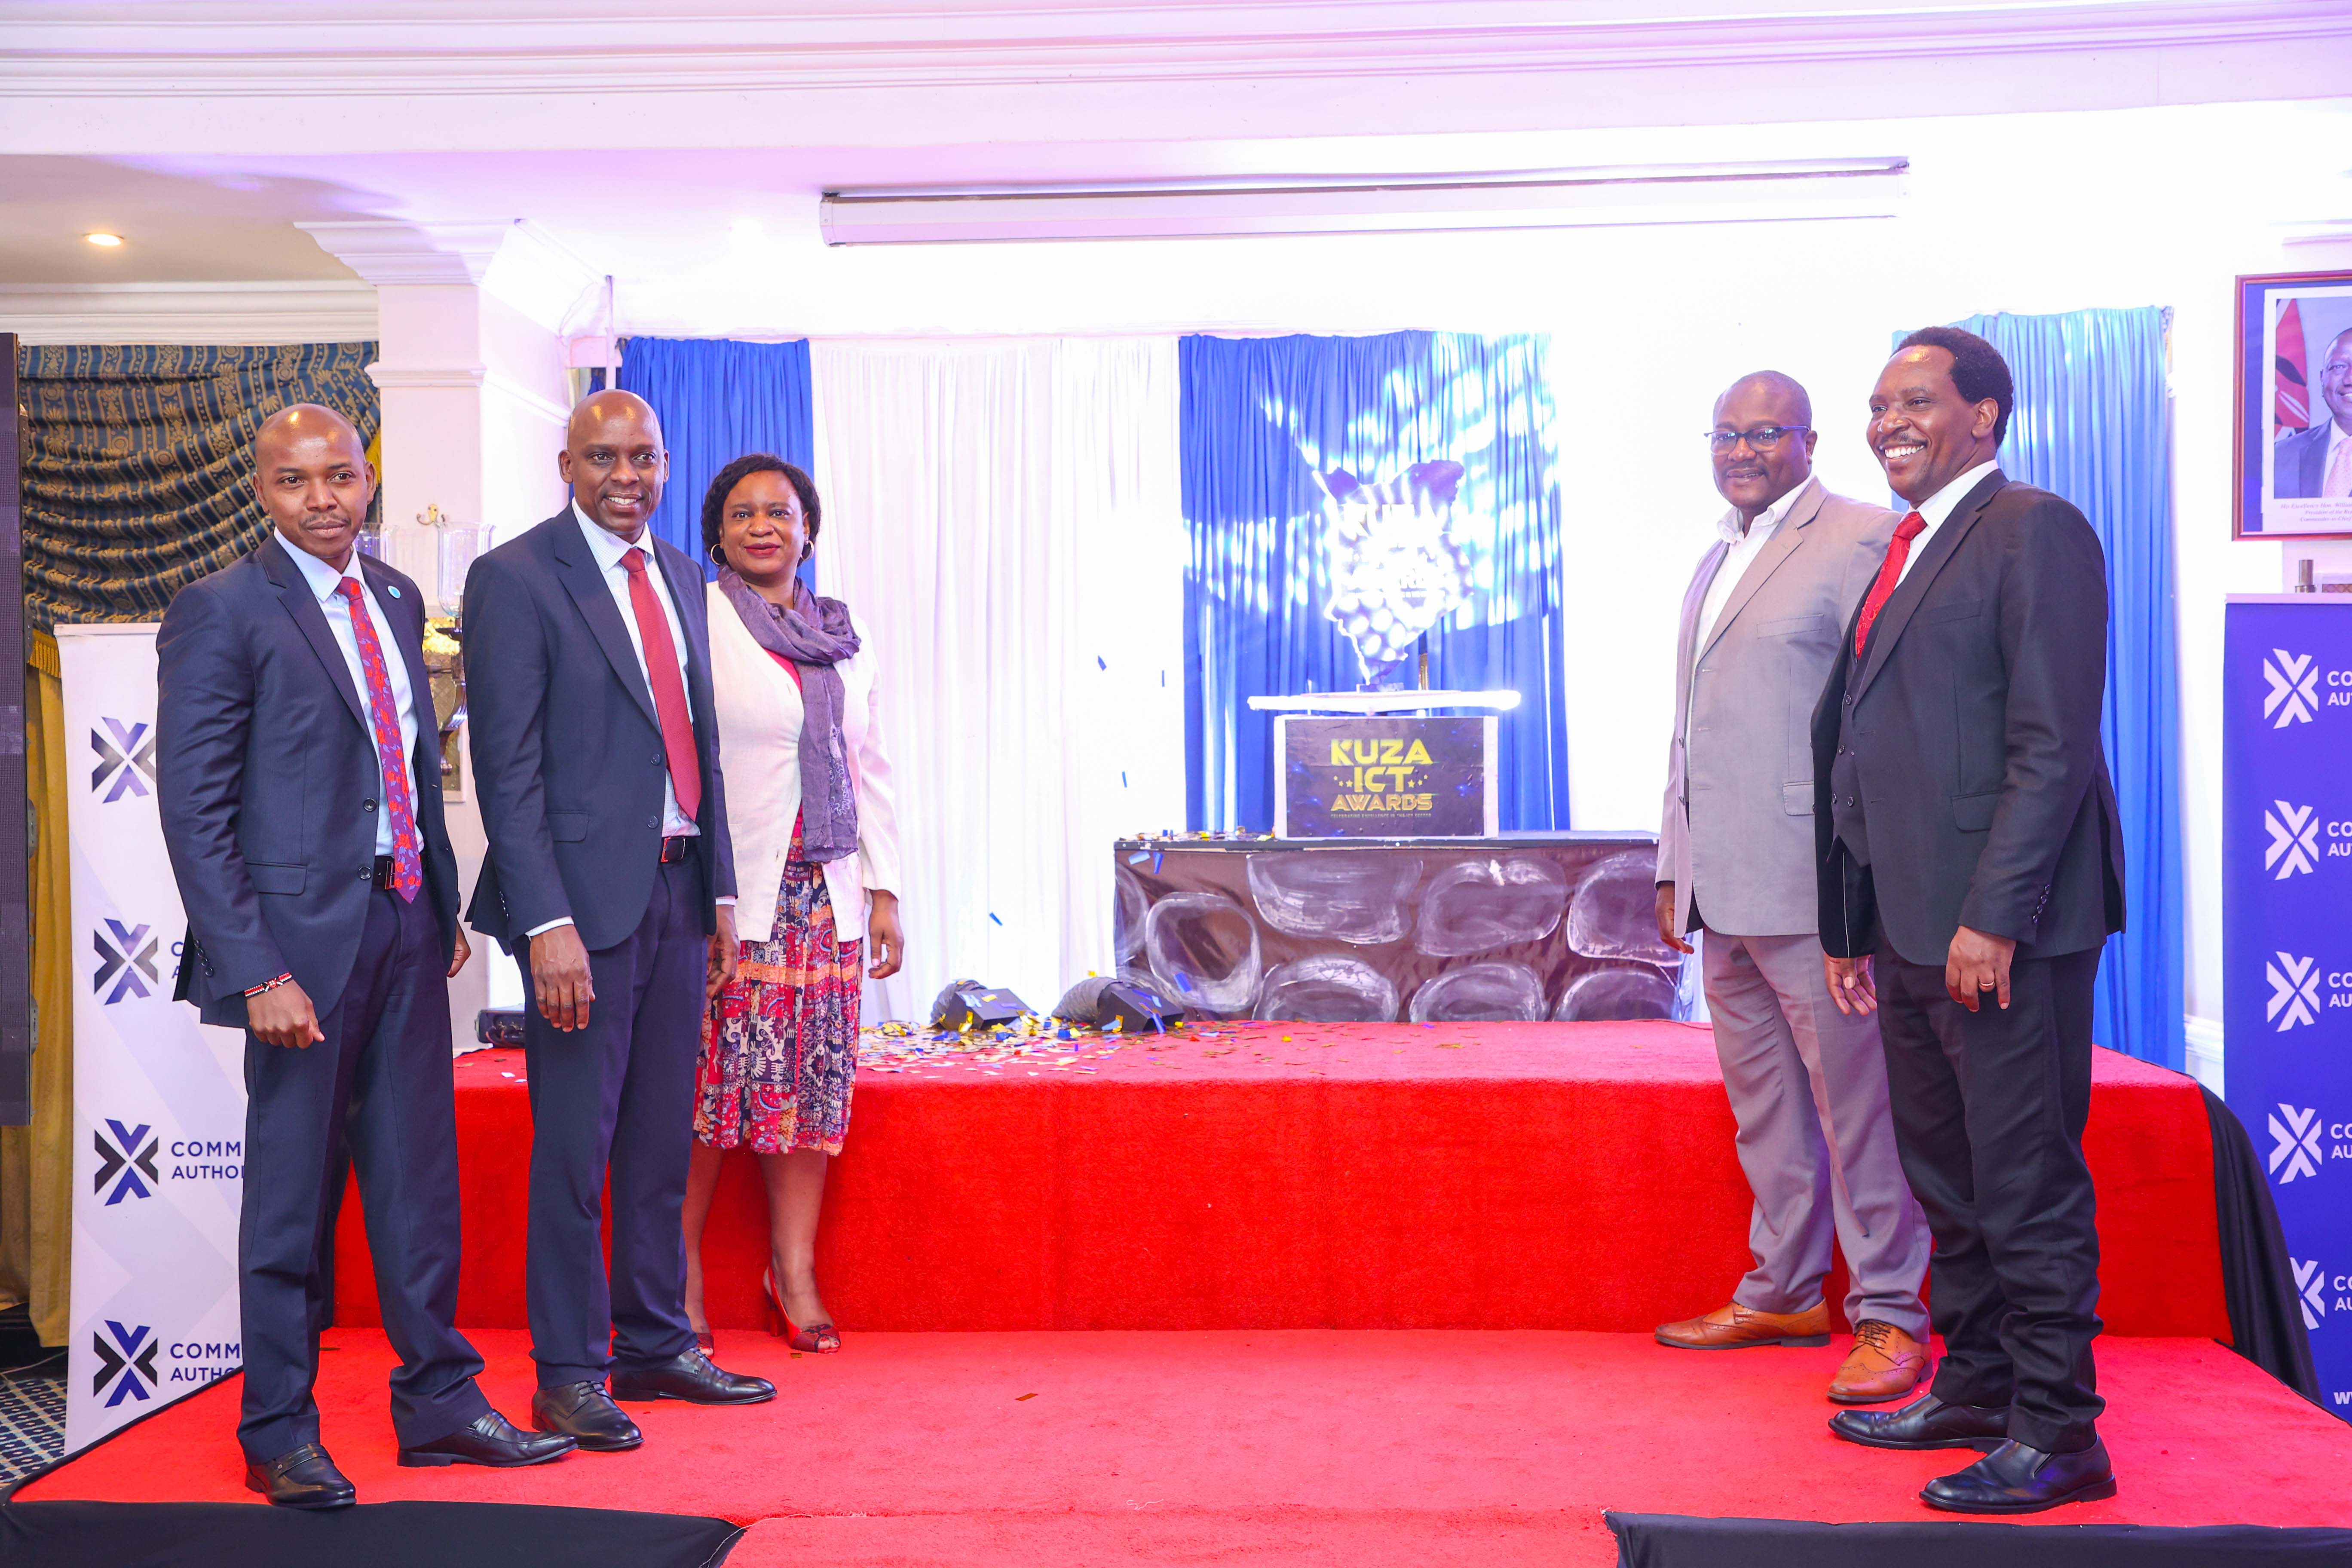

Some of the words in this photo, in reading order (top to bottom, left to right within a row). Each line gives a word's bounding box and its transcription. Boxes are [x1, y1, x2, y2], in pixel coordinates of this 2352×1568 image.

[2327, 692, 2352, 706] AU
[1331, 738, 1433, 766] KUZA
[1354, 766, 1415, 793] ICT
[1330, 793, 1433, 811] AWARDS
[2327, 842, 2352, 857] AU
[171, 1141, 241, 1157] COMM
[172, 1165, 245, 1179] AUTHO
[170, 1343, 240, 1359] COMM
